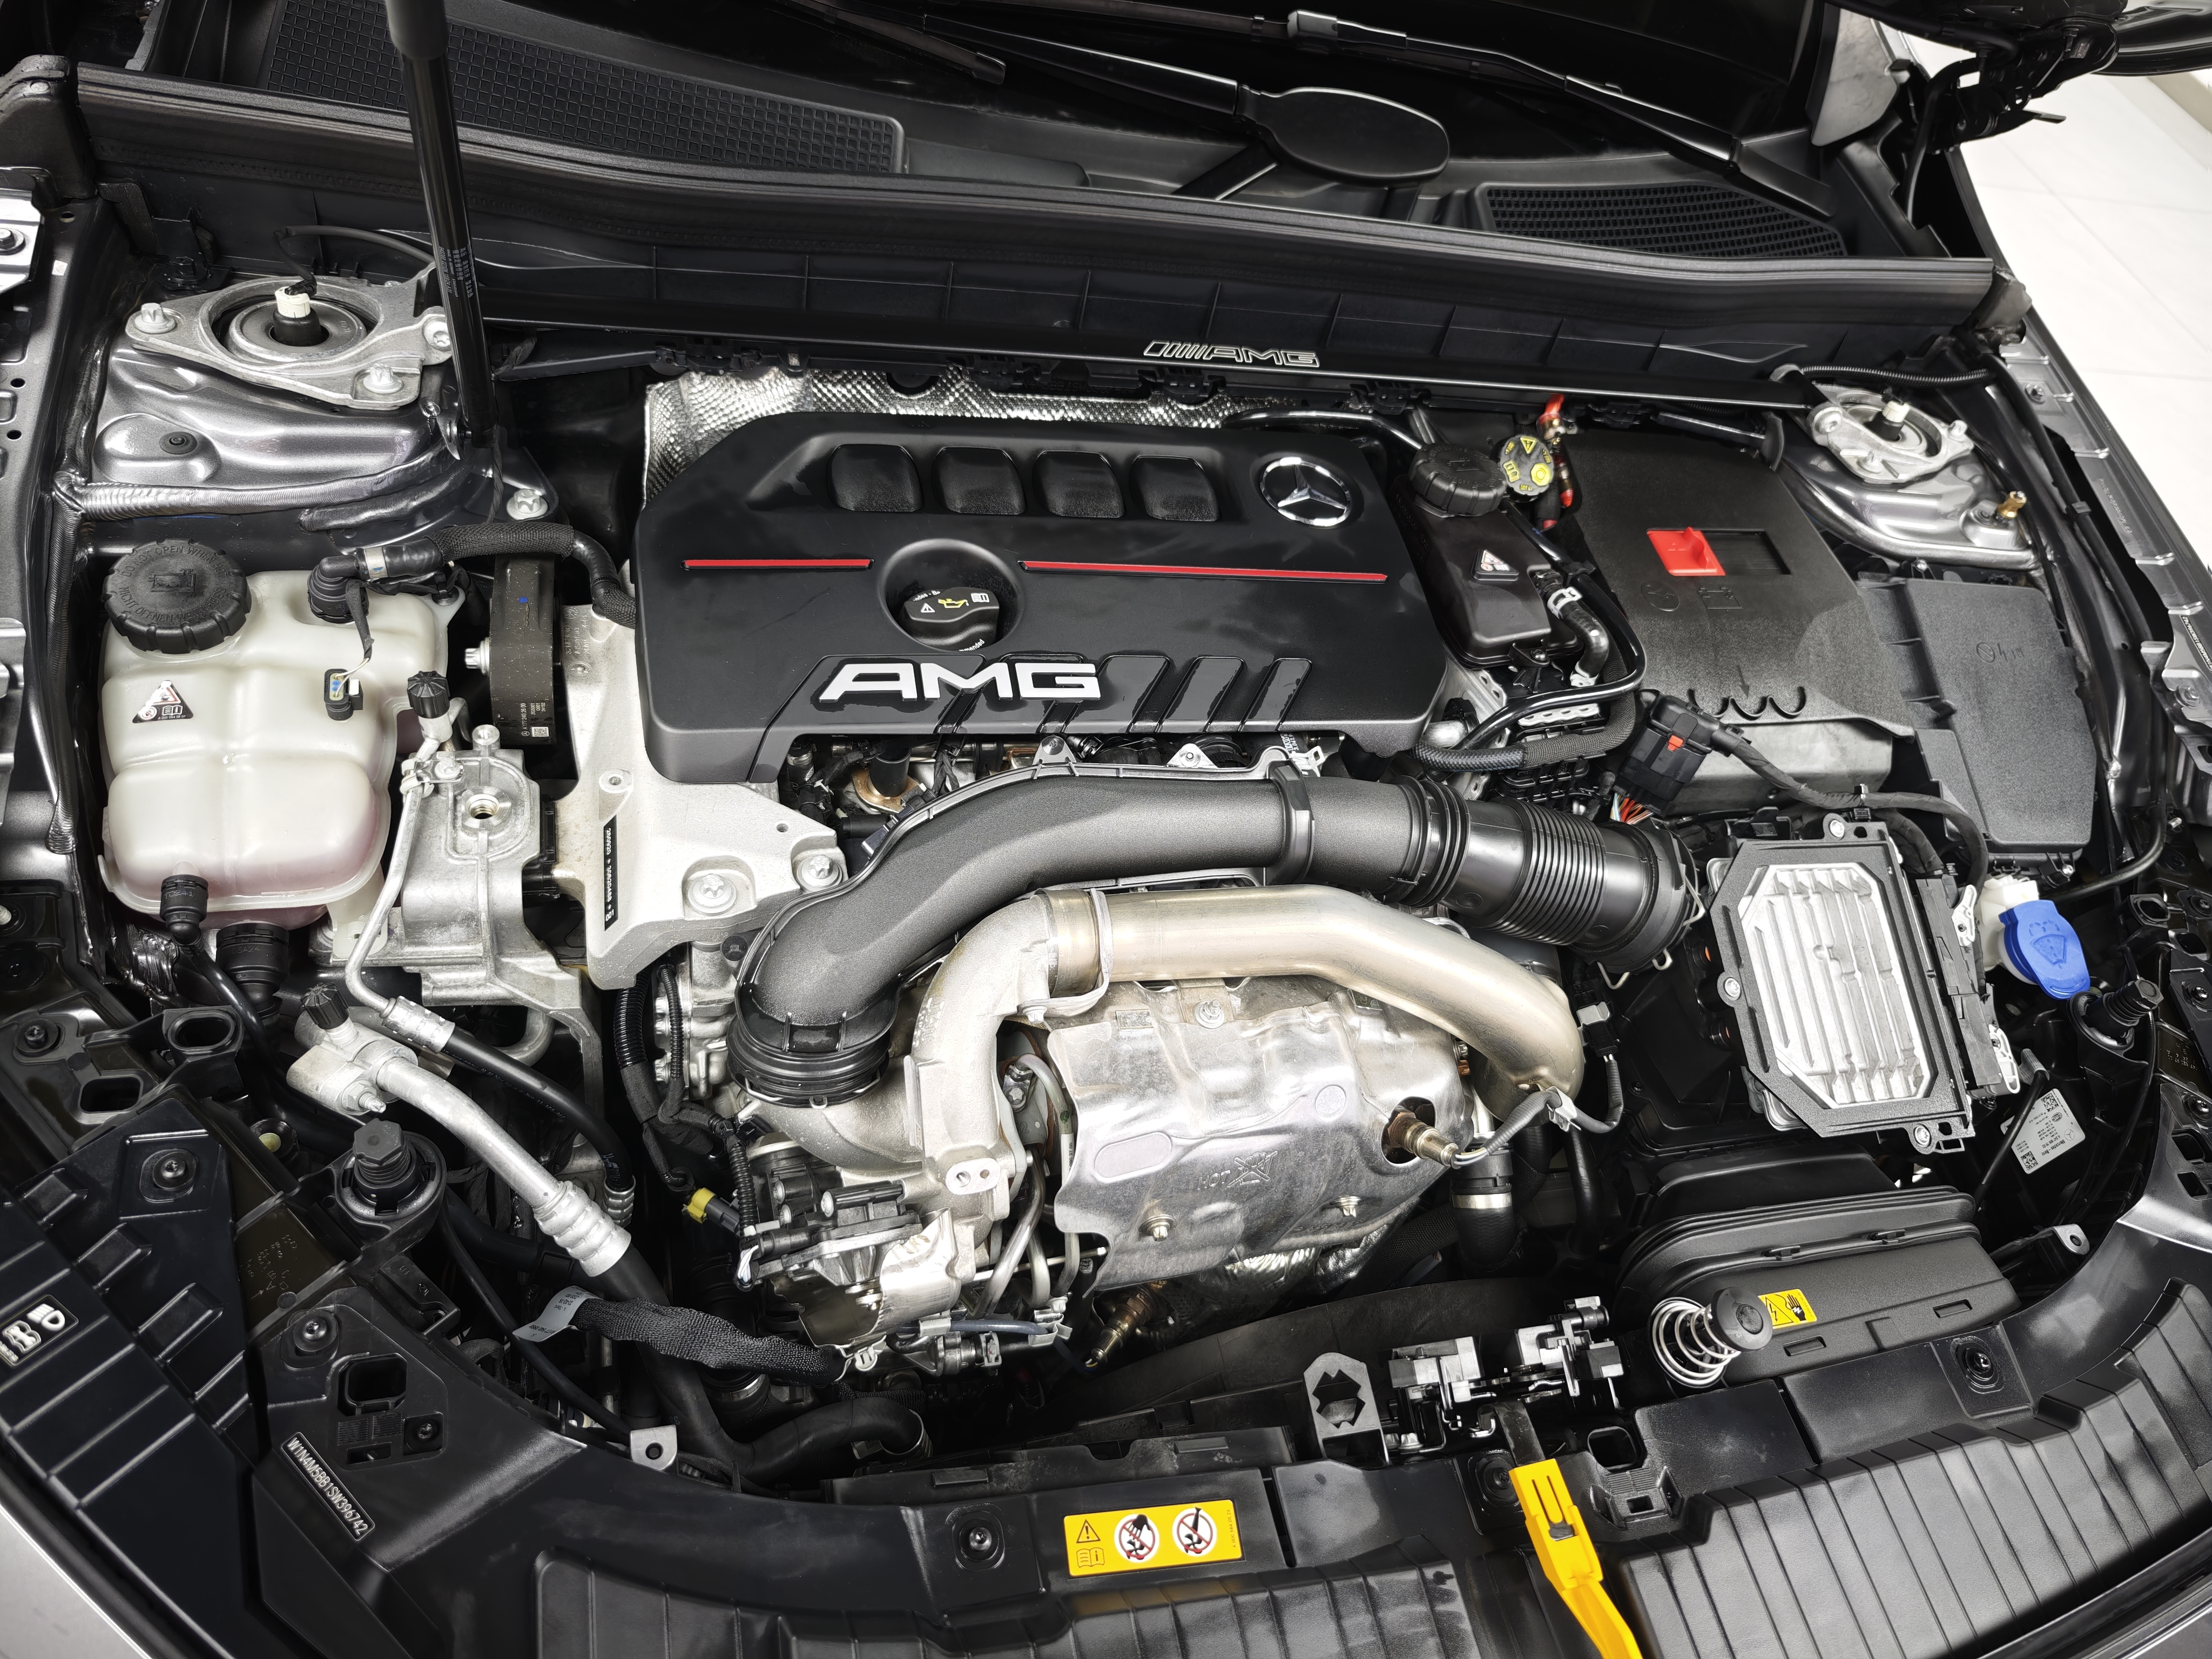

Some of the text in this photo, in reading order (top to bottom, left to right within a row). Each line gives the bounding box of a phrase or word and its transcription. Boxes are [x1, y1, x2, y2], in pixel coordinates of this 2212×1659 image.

[1203, 345, 1319, 367] AMG
[154, 545, 184, 555] OPEN
[819, 663, 1101, 701] AMG
[286, 1437, 368, 1536] W1N4M5BB1SW396742
